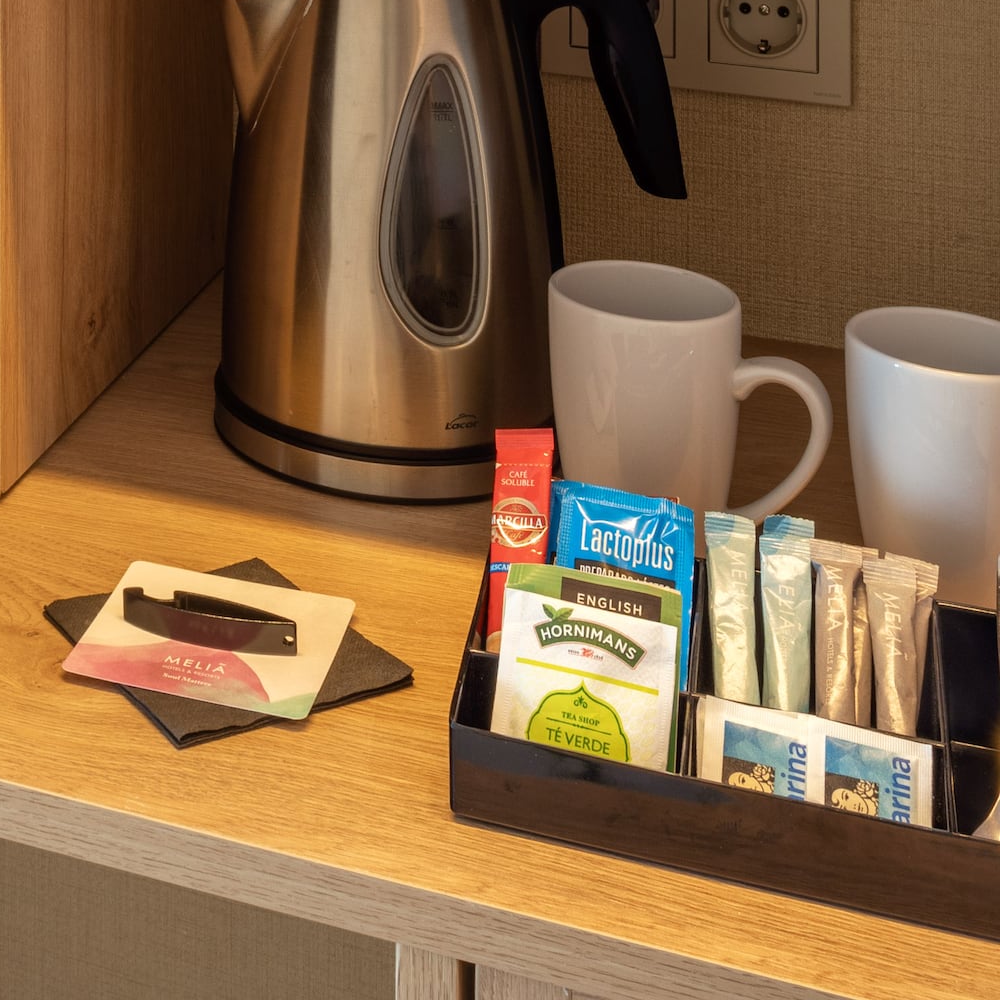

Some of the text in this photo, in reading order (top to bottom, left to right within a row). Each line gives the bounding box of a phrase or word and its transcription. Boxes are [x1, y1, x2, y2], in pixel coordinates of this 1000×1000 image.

[500, 478, 535, 487] SOLUBLE
[509, 470, 528, 479] CAFÉ
[580, 519, 674, 571] Lactoplus
[576, 593, 643, 616] ENGLISH
[541, 624, 637, 660] HORNIMANS
[561, 711, 600, 727] TEA SHOP
[546, 727, 611, 755] TÉ VERDE
